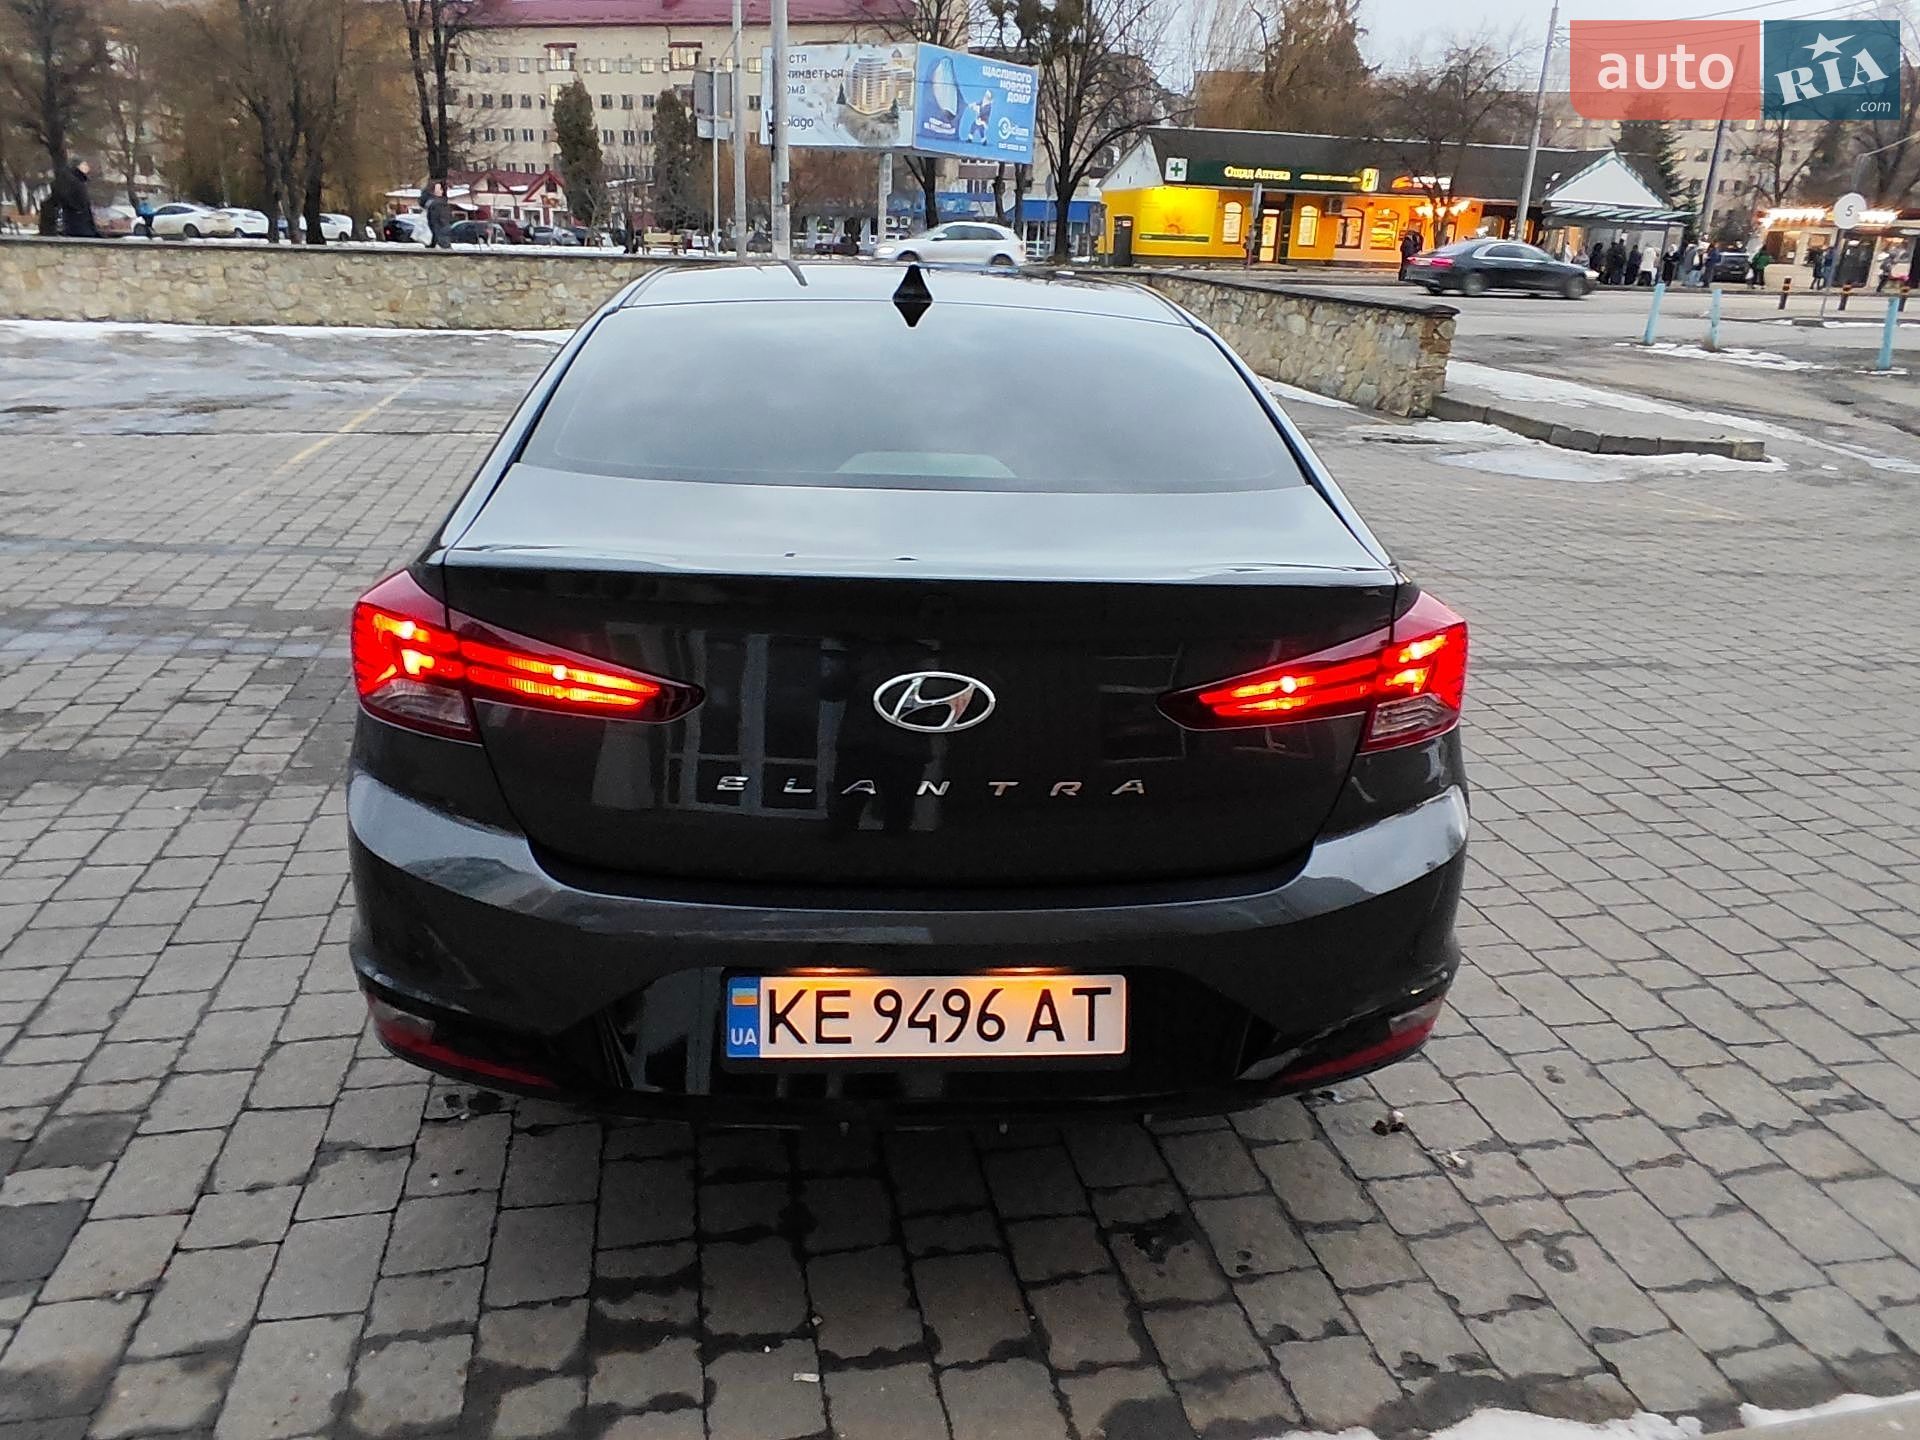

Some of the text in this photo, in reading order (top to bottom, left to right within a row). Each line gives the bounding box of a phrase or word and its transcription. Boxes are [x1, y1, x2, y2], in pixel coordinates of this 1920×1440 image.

[789, 54, 807, 64] стя
[1845, 205, 1855, 217] 5
[716, 775, 1146, 797] ELANTRA
[768, 986, 1112, 1045] KE 9496 AT
[731, 1028, 757, 1046] UA
